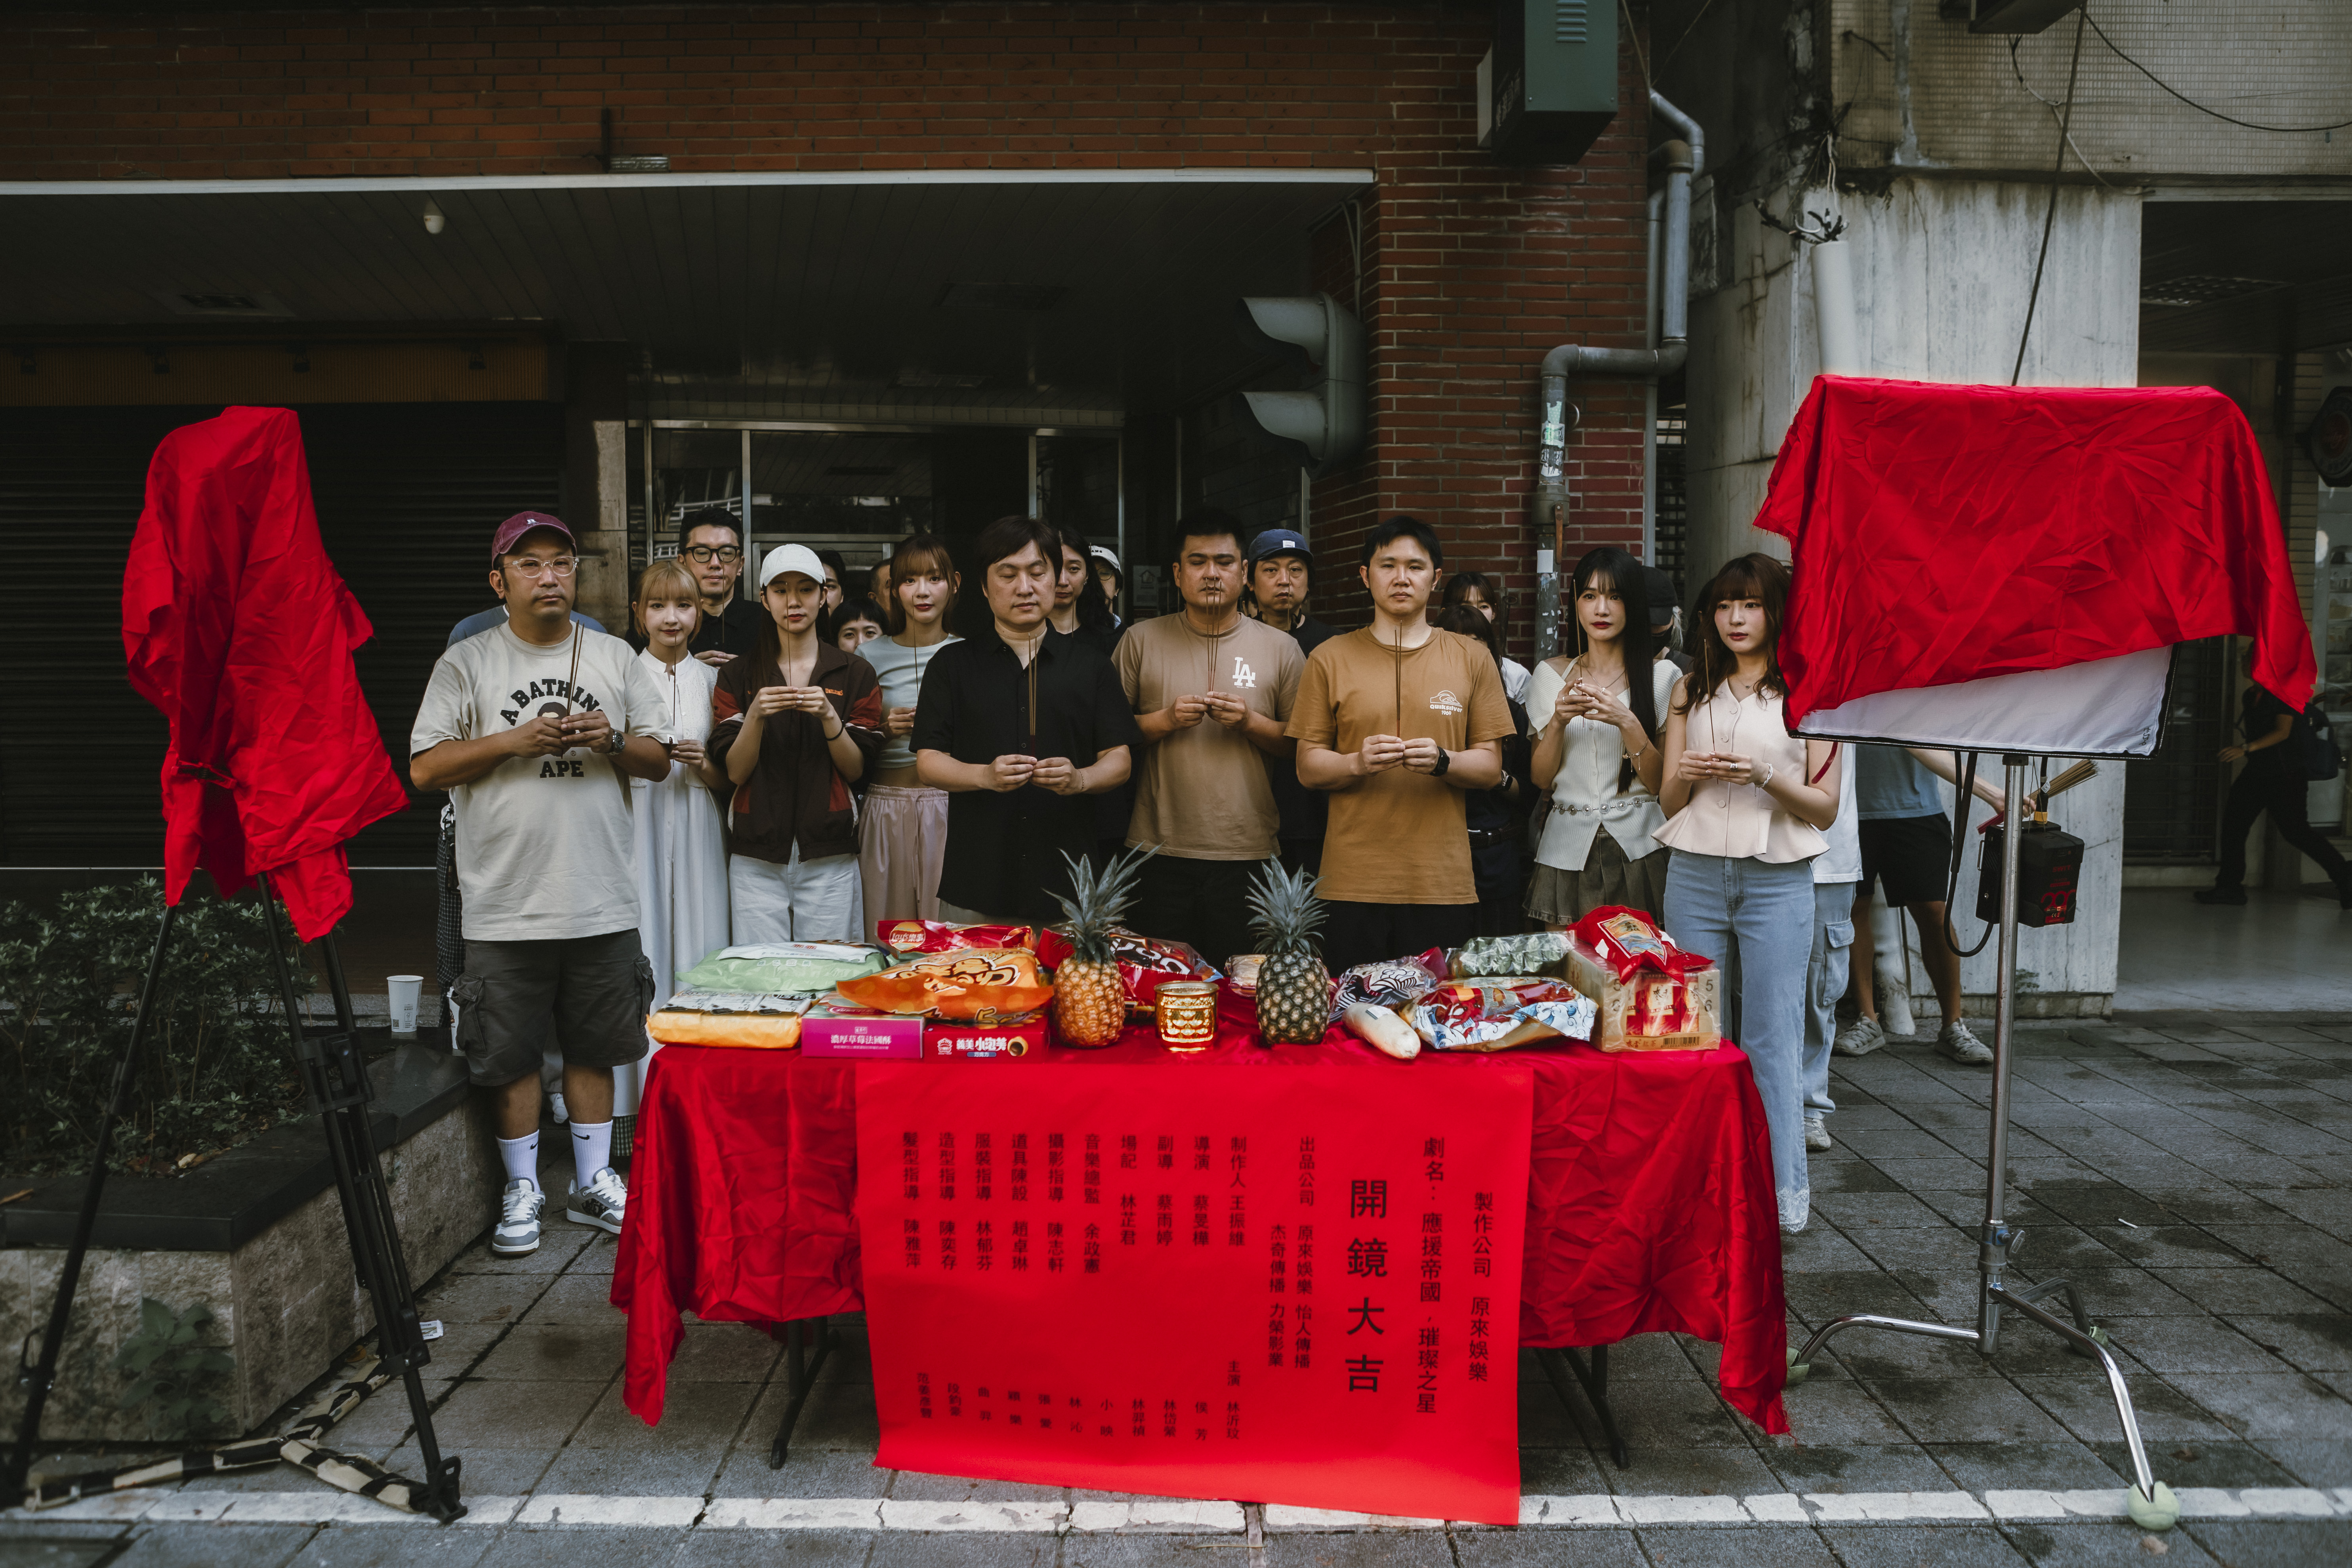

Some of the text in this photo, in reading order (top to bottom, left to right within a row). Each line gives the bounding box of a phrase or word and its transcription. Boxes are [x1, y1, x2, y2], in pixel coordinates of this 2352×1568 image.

[1232, 657, 1256, 687] LA
[500, 679, 603, 726] A BATHIN
[540, 760, 584, 778] APE
[891, 933, 909, 942] Lay's
[1705, 979, 1713, 991] 5
[1705, 1000, 1712, 1012] 6
[956, 1037, 1007, 1051] 義美 小泡芙
[903, 1131, 919, 1200] 髮型指導
[939, 1132, 955, 1201] 造型指導
[975, 1133, 992, 1201] 服裝指導
[1011, 1133, 1028, 1201] 道具陳設
[1084, 1133, 1100, 1204] 音樂總監
[1121, 1135, 1137, 1169] 場記
[1158, 1136, 1173, 1170] 副導
[1194, 1136, 1210, 1170] 導演
[1048, 1133, 1064, 1272] 攝影指導 陳志軒
[1229, 1136, 1246, 1246] 制作人 王振維
[1270, 1224, 1286, 1293] 杰奇傳播
[1295, 1136, 1315, 1368] 出品公司 原來娛樂 怡人傳播
[1345, 1180, 1388, 1392] 開鏡大吉
[1469, 1192, 1493, 1381] 製作公司 原來娛樂
[1228, 1360, 1240, 1386] 主演
